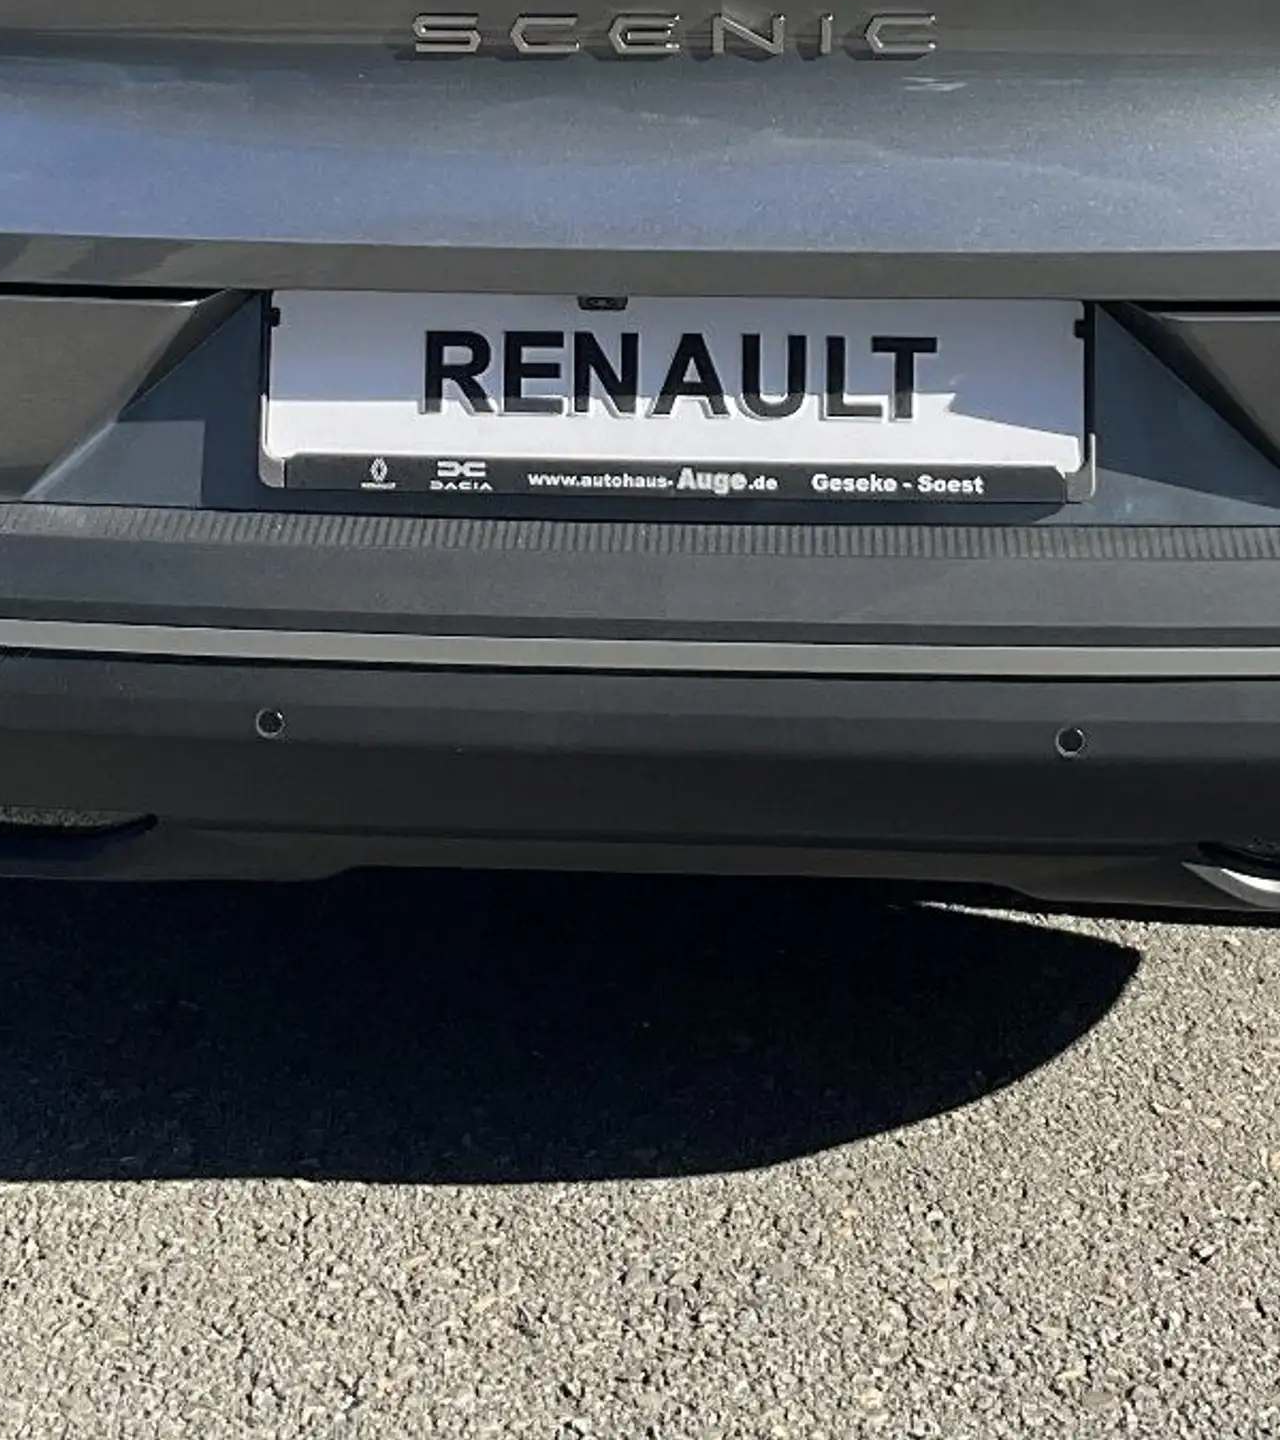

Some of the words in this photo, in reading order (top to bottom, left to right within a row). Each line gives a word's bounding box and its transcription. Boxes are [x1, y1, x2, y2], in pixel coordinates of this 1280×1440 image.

[412, 13, 936, 54] SCENIC
[423, 329, 938, 420] RENAULT
[430, 480, 493, 491] DACIA
[811, 473, 897, 492] Geseke
[918, 474, 985, 494] Soest
